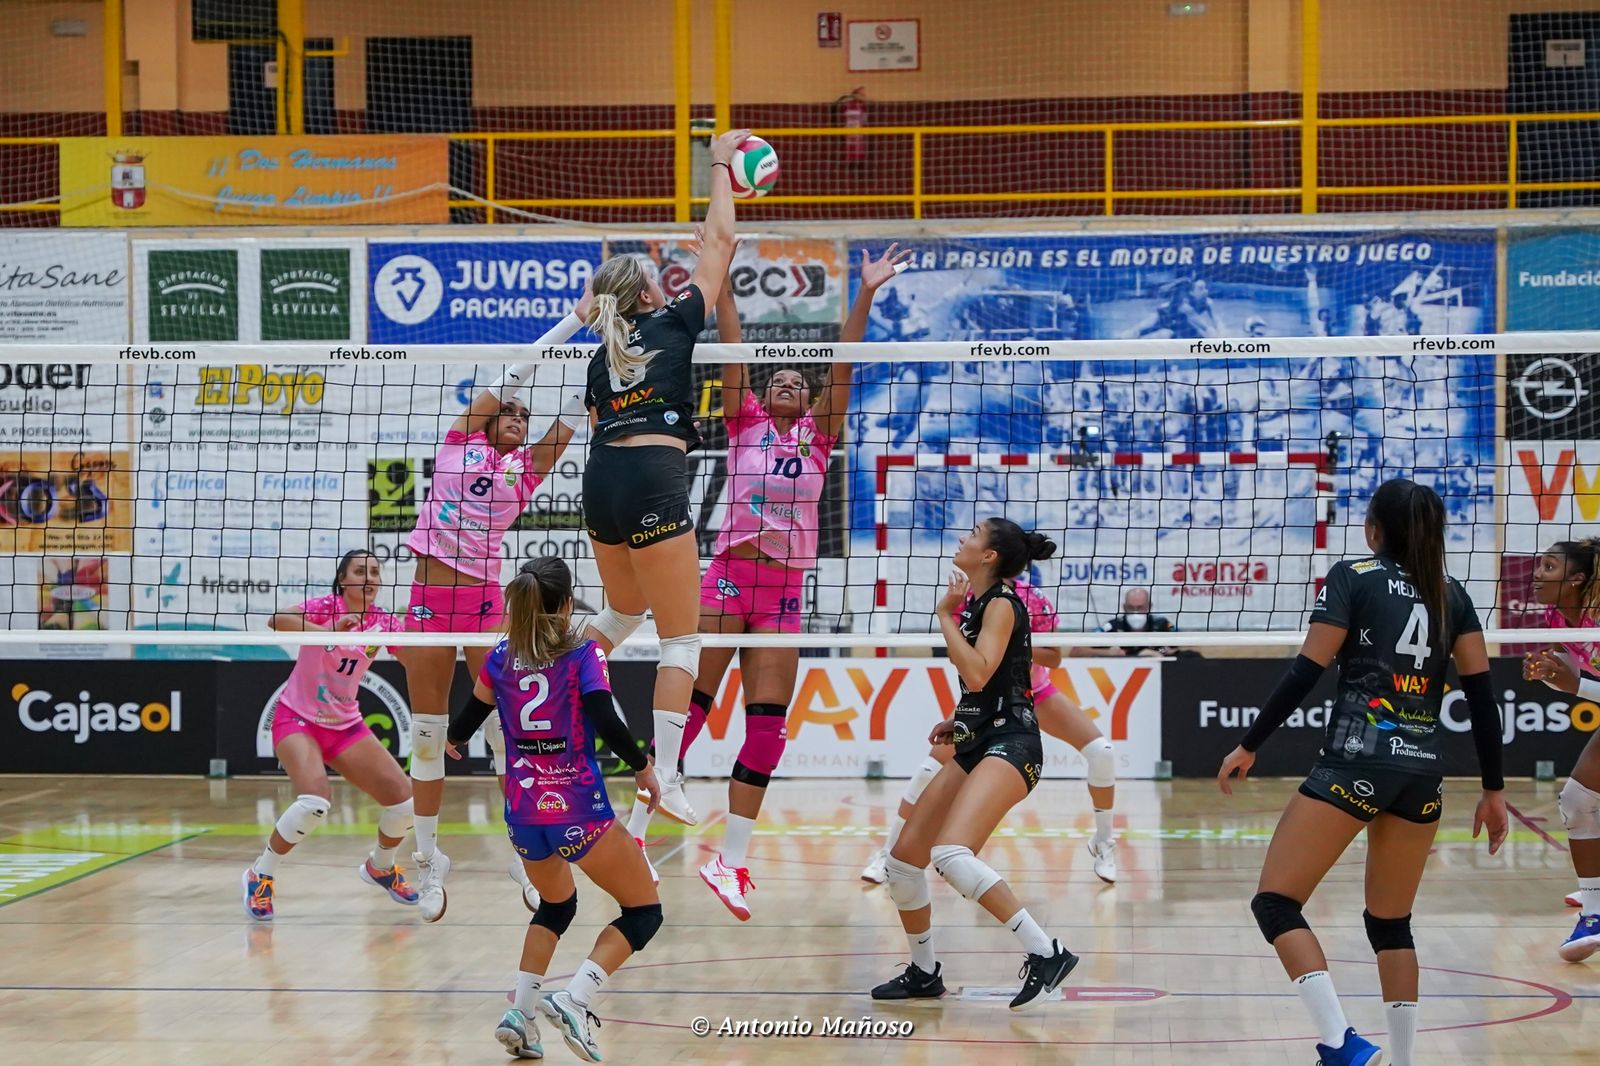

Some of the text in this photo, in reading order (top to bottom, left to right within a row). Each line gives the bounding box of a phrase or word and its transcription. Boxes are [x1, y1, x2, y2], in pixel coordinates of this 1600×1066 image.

[912, 242, 1432, 269] LA PASIÓN ES EL MOTOR DE NUESTRO JUEGO
[449, 259, 594, 291] JUVASA
[160, 304, 228, 317] SEVILLA
[272, 303, 340, 316] SEVILLA
[450, 297, 580, 319] PACKAGIN
[119, 346, 196, 360] rfevb.com
[330, 346, 407, 360] rfevb.com
[541, 347, 595, 360] rfevb.c
[755, 345, 833, 358] rfevb.com
[970, 343, 1050, 356] rfevb.com
[1190, 341, 1271, 354] rfevb.com
[1413, 337, 1495, 351] rfevb.com
[195, 363, 326, 415] El Poyo
[610, 387, 654, 412] WAY
[771, 457, 803, 479] 10
[470, 476, 493, 497] 8
[631, 521, 678, 544] Divisa
[1061, 563, 1147, 581] JUVASA
[1172, 561, 1269, 583] avanza
[202, 575, 270, 595] triana
[1170, 585, 1254, 597] PACKAGING
[1395, 603, 1432, 670] 4
[336, 657, 359, 676] 11
[1392, 673, 1430, 695] WAY
[518, 673, 552, 731] 2
[18, 690, 182, 744] Cajasol
[1439, 689, 1600, 744] Cjaso
[541, 741, 566, 751] Cajasol
